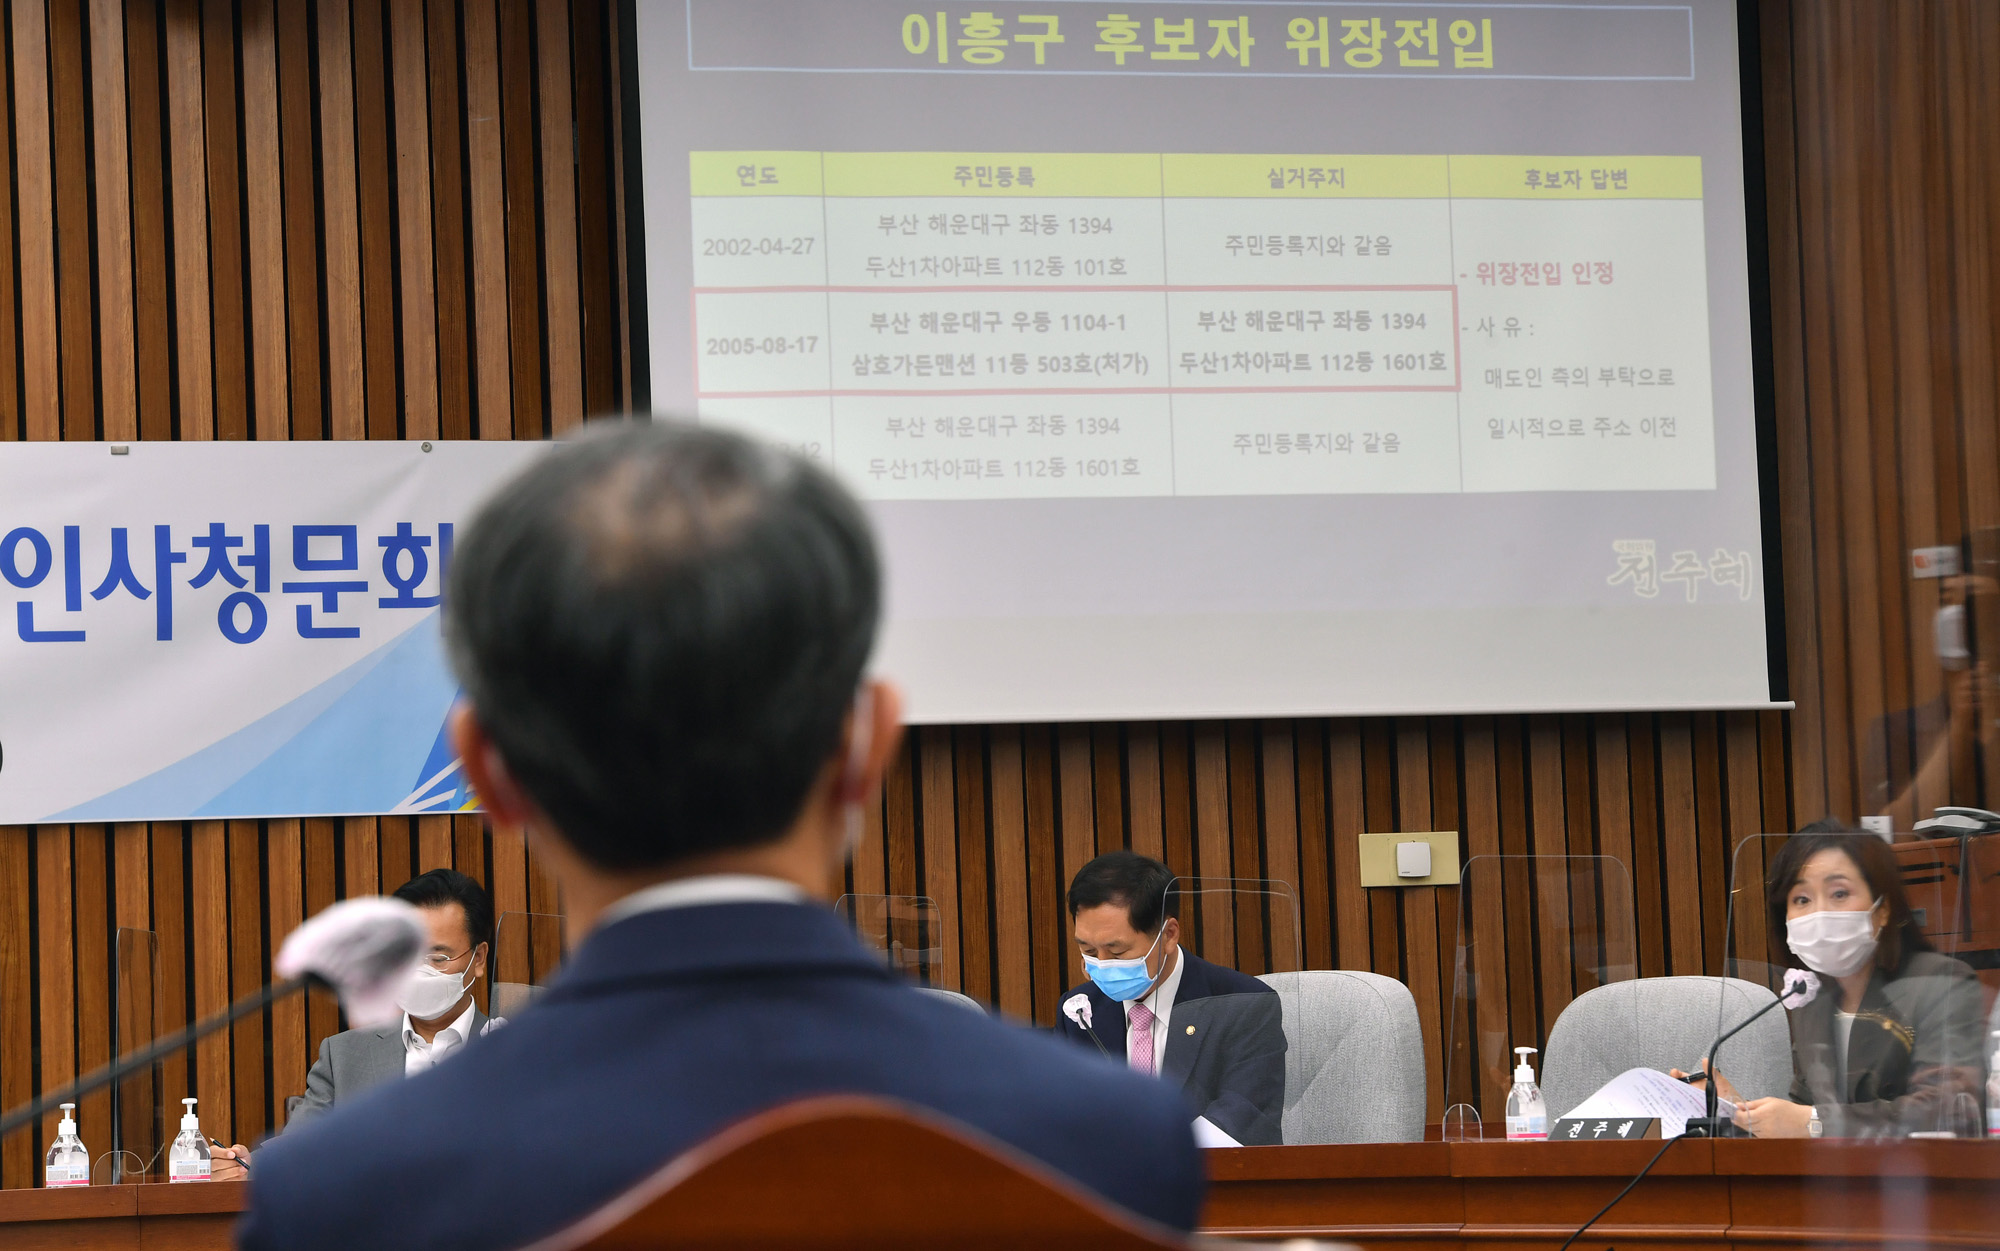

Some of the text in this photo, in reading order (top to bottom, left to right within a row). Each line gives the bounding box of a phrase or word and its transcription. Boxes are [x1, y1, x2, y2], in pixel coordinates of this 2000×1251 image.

[901, 10, 1496, 69] 이흥구 후보자 위장전입
[736, 164, 779, 187] 연도
[953, 165, 1036, 188] 주민등록
[1267, 166, 1346, 189] 실거주지
[1523, 167, 1630, 191] 후보자 답변
[877, 213, 1113, 236] 부산 해운대구 좌동 1394
[703, 236, 815, 257] 2002-04-27
[1224, 234, 1393, 257] 주민등록지와 같음
[865, 255, 1128, 278] 두산1차아파트 112동 101호
[1475, 261, 1562, 286] 위장전입
[1571, 261, 1615, 286] 인정
[869, 311, 1127, 335] 부산 해운대구 우동 1104-1
[1197, 310, 1427, 333] 부산 해운대구 좌동 1394
[706, 335, 819, 356] 2005-08-17
[851, 351, 1149, 376] 삼호가든맨션 11동 503호(처가)
[1179, 350, 1448, 374] 두산1차아파트 112동 1601호
[1484, 366, 1676, 390] 매도인 측의 부탁으로
[884, 414, 1121, 438] 부산 해운대구 좌동 1394
[1487, 416, 1678, 440] 일시적으로 주소 이전
[1233, 431, 1402, 456] 주민등록지와 같음
[868, 456, 1142, 480] 두산1차아파트 112동 1601호
[0, 522, 455, 645] 인사청문회
[1607, 548, 1752, 603] 전주혜
